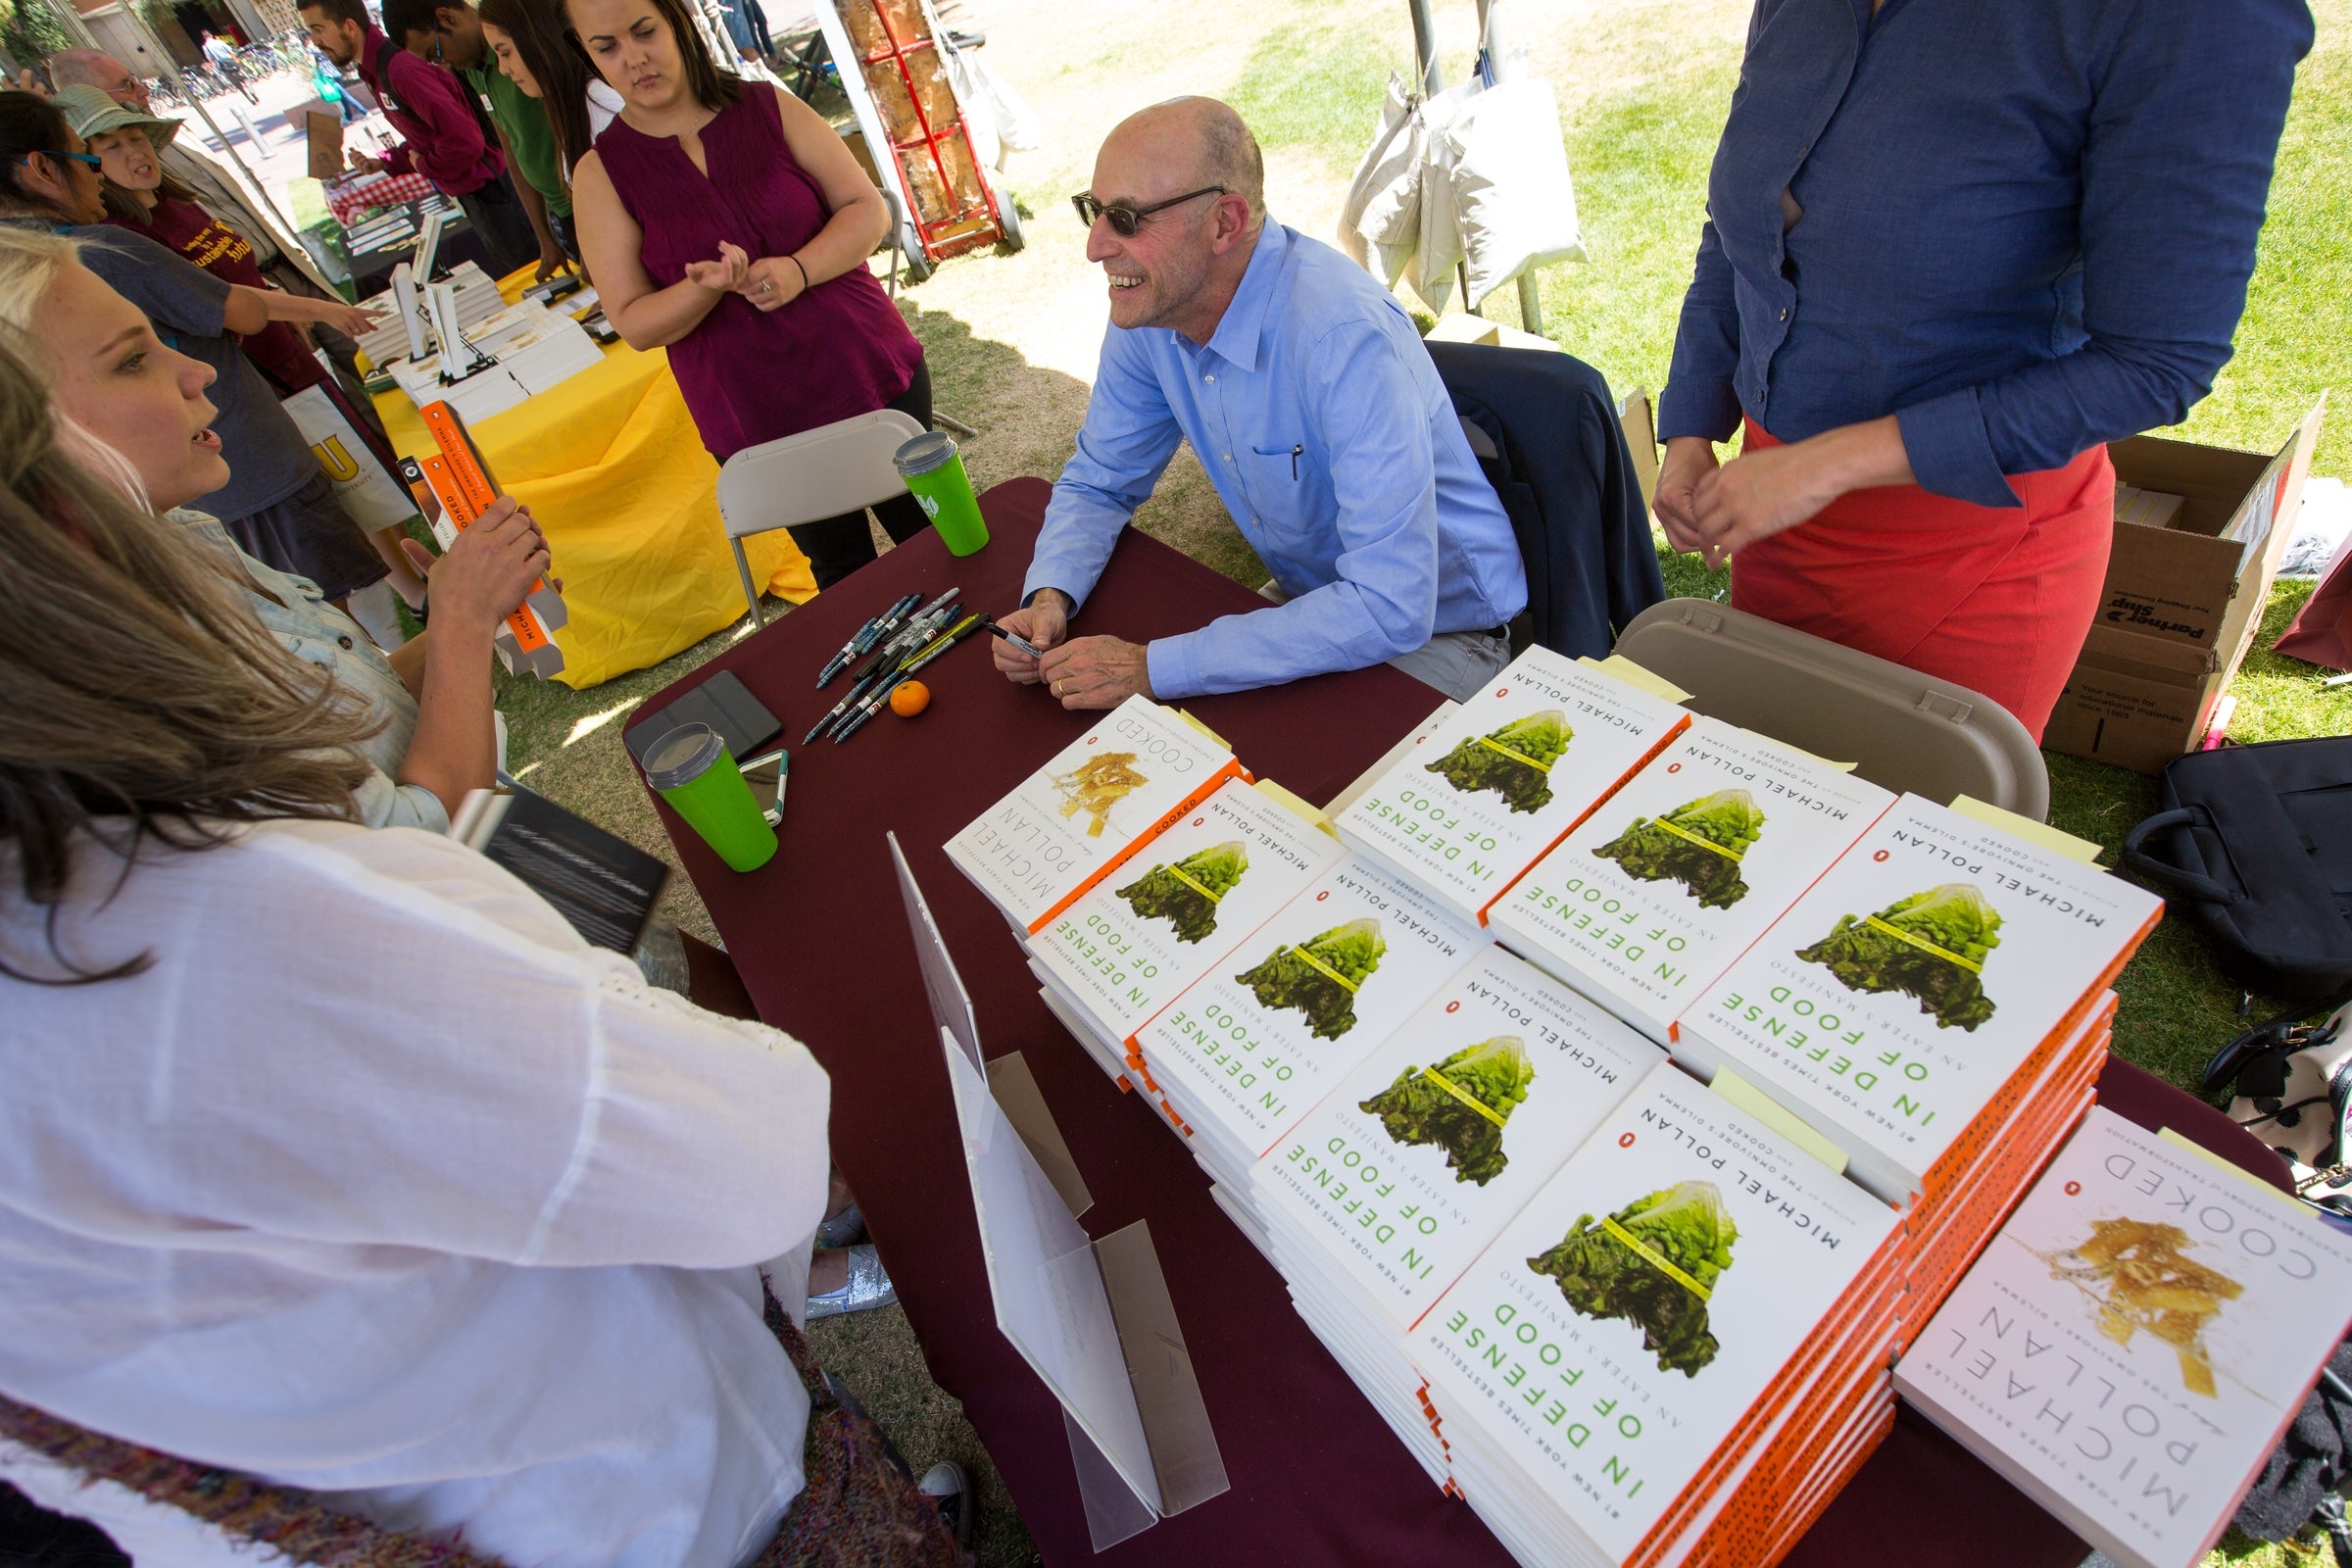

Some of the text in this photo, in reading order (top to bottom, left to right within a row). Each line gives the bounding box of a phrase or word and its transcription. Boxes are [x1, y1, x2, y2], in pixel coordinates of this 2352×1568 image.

[194, 235, 234, 268] ustainable
[436, 426, 454, 452] DILEMMA
[451, 452, 473, 488] OMNIVORE'S
[445, 494, 468, 528] OOKED
[470, 488, 479, 500] THE
[513, 608, 534, 640] MICHA
[2111, 598, 2154, 616] Ship
[2127, 615, 2205, 640] Partner
[1513, 674, 1642, 735] MICHAEL POLLAN
[2078, 702, 2103, 712] since
[2079, 693, 2184, 723] educational materials
[2082, 684, 2156, 708] Your source for
[1117, 719, 1194, 772] COOKED
[1599, 771, 1633, 807] DEFENSE
[1635, 760, 1645, 772] OF
[1646, 740, 1667, 760] FOOD
[1687, 747, 1848, 819] MICHAEL POLLAN
[974, 822, 1054, 898] MICHAEL
[999, 808, 1075, 872] POLLAN
[1211, 804, 1308, 870] MICHAEL POLLAN
[1365, 799, 1494, 880] IN DEFENSE
[1400, 792, 1495, 851] OF FOOD
[1909, 817, 2062, 885] THE OMNIVORE'S DILEMMA
[1981, 838, 2029, 858] COOKED
[1337, 875, 1456, 956] MICHAEL POLLAN
[1566, 879, 1686, 951] OF FOOD
[1893, 831, 2104, 927] MICHAEL POLLAN
[1056, 921, 1149, 1007] IN DEFENSE
[1088, 915, 1157, 978] OF FOOD
[1513, 905, 1668, 1000] #1 NEW YORK TIMES BESTSELLER
[1526, 887, 1686, 986] IN DEFENSE
[1205, 1005, 1292, 1080] OF FOOD
[1467, 982, 1617, 1084] MICHAEL POLLAN
[1771, 961, 1966, 1071] AN EATER'S MANIFESTO
[1771, 987, 1928, 1080] OF FOOD
[1170, 1011, 1286, 1116] IN DEFENSE
[1709, 1013, 1916, 1143] #1 NEW YORK TIMES BESTSELLER
[1723, 994, 1935, 1125] IN DEFENSE
[1659, 1094, 1802, 1192] THE OMNIVORE'S DILEMMA
[1729, 1123, 1773, 1154] COOKED
[1930, 1045, 2046, 1179] MICHAEL POLLAN
[1328, 1139, 1437, 1235] OF FOOD
[1642, 1109, 1839, 1249] MICHAEL POLLAN
[1913, 1091, 2021, 1222] MICHAEL POLLAN
[1273, 1165, 1411, 1296] #1 NEW YORK TIMES BESTSELLER
[1288, 1145, 1433, 1279] IN DEFENSE
[2105, 1154, 2317, 1280] COOKED
[1495, 1304, 1642, 1439] OF FOOD
[1500, 1271, 1681, 1430] AN EATER'S MANIFESTO
[1980, 1306, 2197, 1466] POLLAN
[1431, 1337, 1620, 1519] #1 NEW YORK TIMES BESTSELLER
[1446, 1311, 1642, 1497] IN DEFENSE
[1950, 1329, 2187, 1517] MICHAEL
